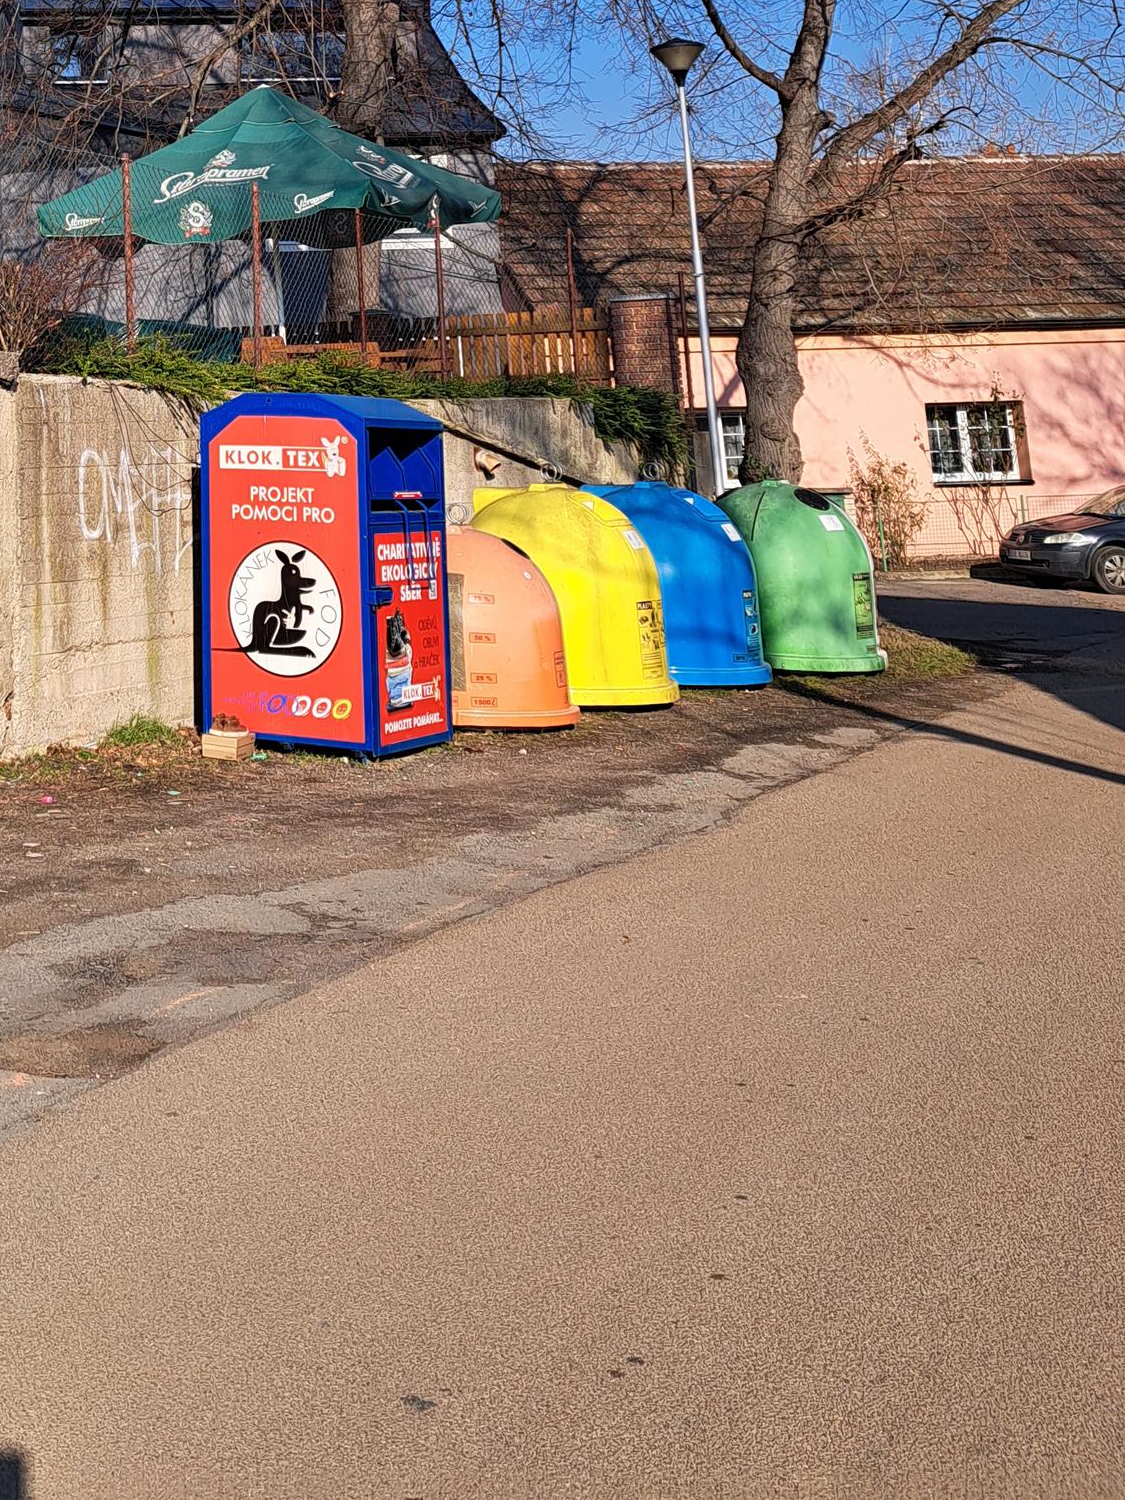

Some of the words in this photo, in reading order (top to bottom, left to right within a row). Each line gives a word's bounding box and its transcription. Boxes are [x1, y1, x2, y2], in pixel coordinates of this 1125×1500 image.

[286, 450, 320, 467] TEX
[250, 486, 314, 504] PROJEKT
[231, 503, 298, 522] POMOCI
[302, 506, 335, 524] PRO
